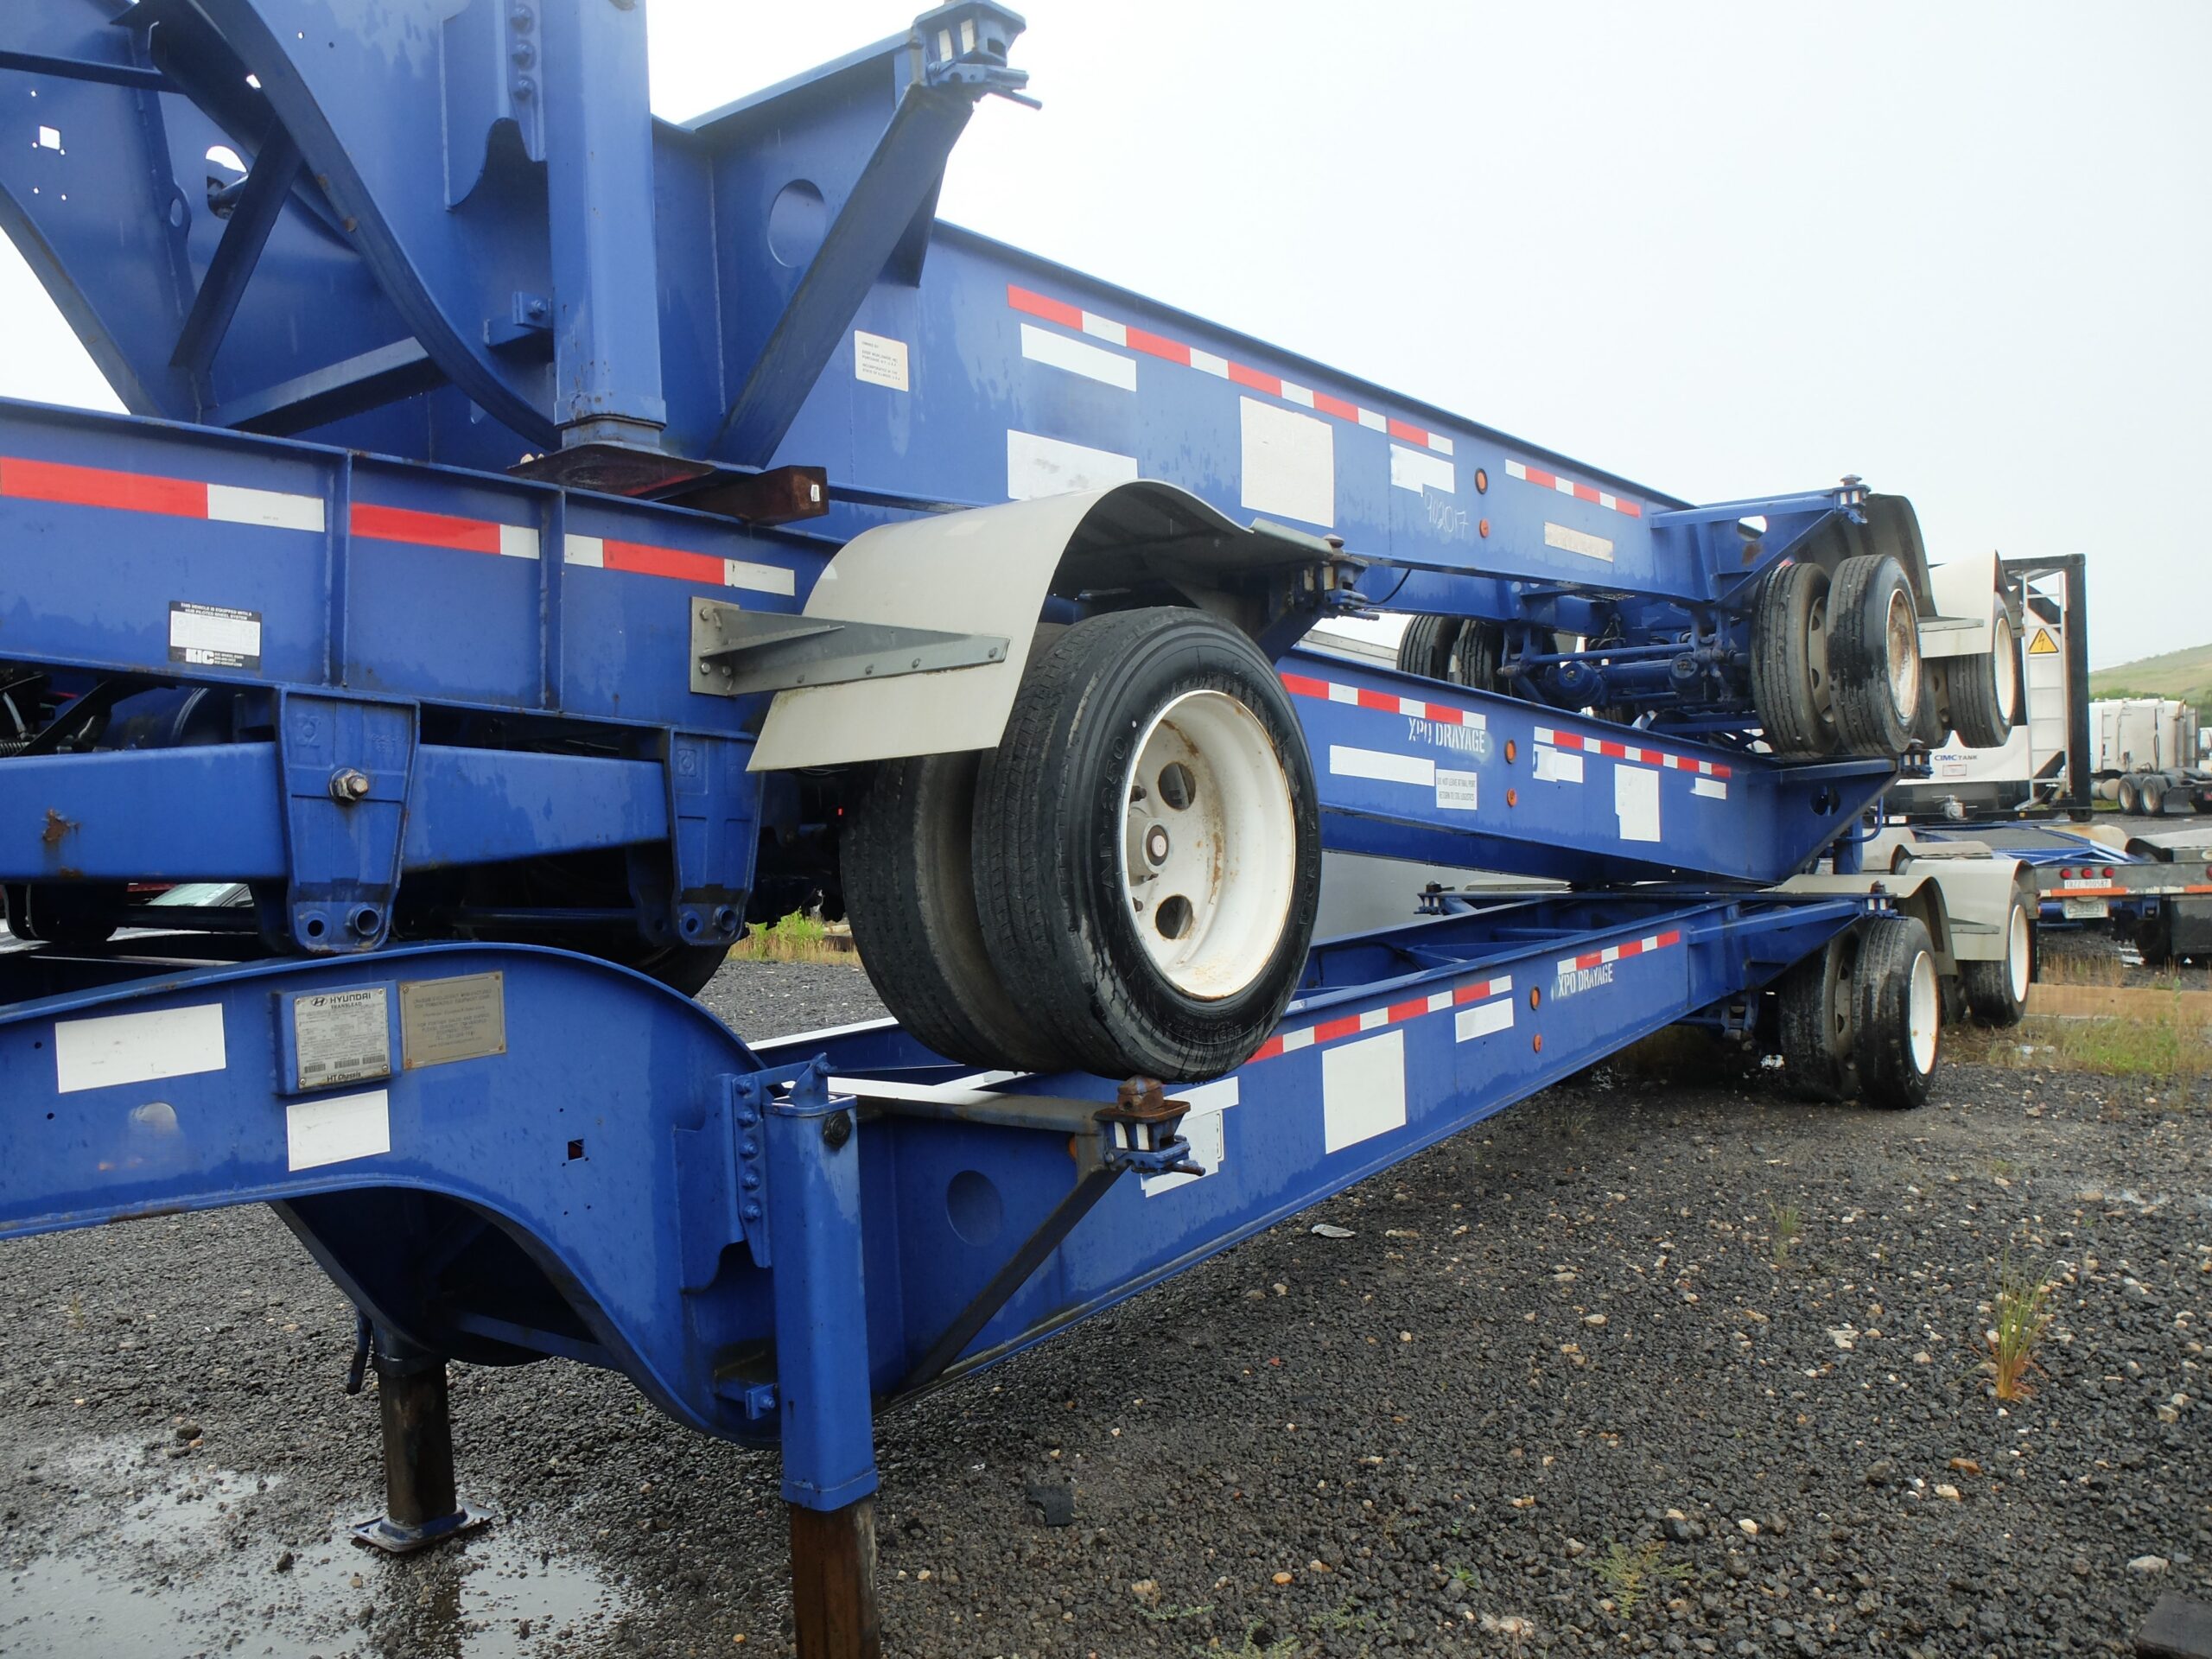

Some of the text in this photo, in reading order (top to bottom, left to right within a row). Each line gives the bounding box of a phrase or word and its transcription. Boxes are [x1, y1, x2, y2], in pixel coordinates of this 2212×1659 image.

[1435, 722, 1485, 753] DRAYAGE
[1558, 963, 1613, 996] XPO DRAYAGE
[330, 993, 371, 1004] HYUNDAI
[338, 1071, 361, 1081] Chassis
